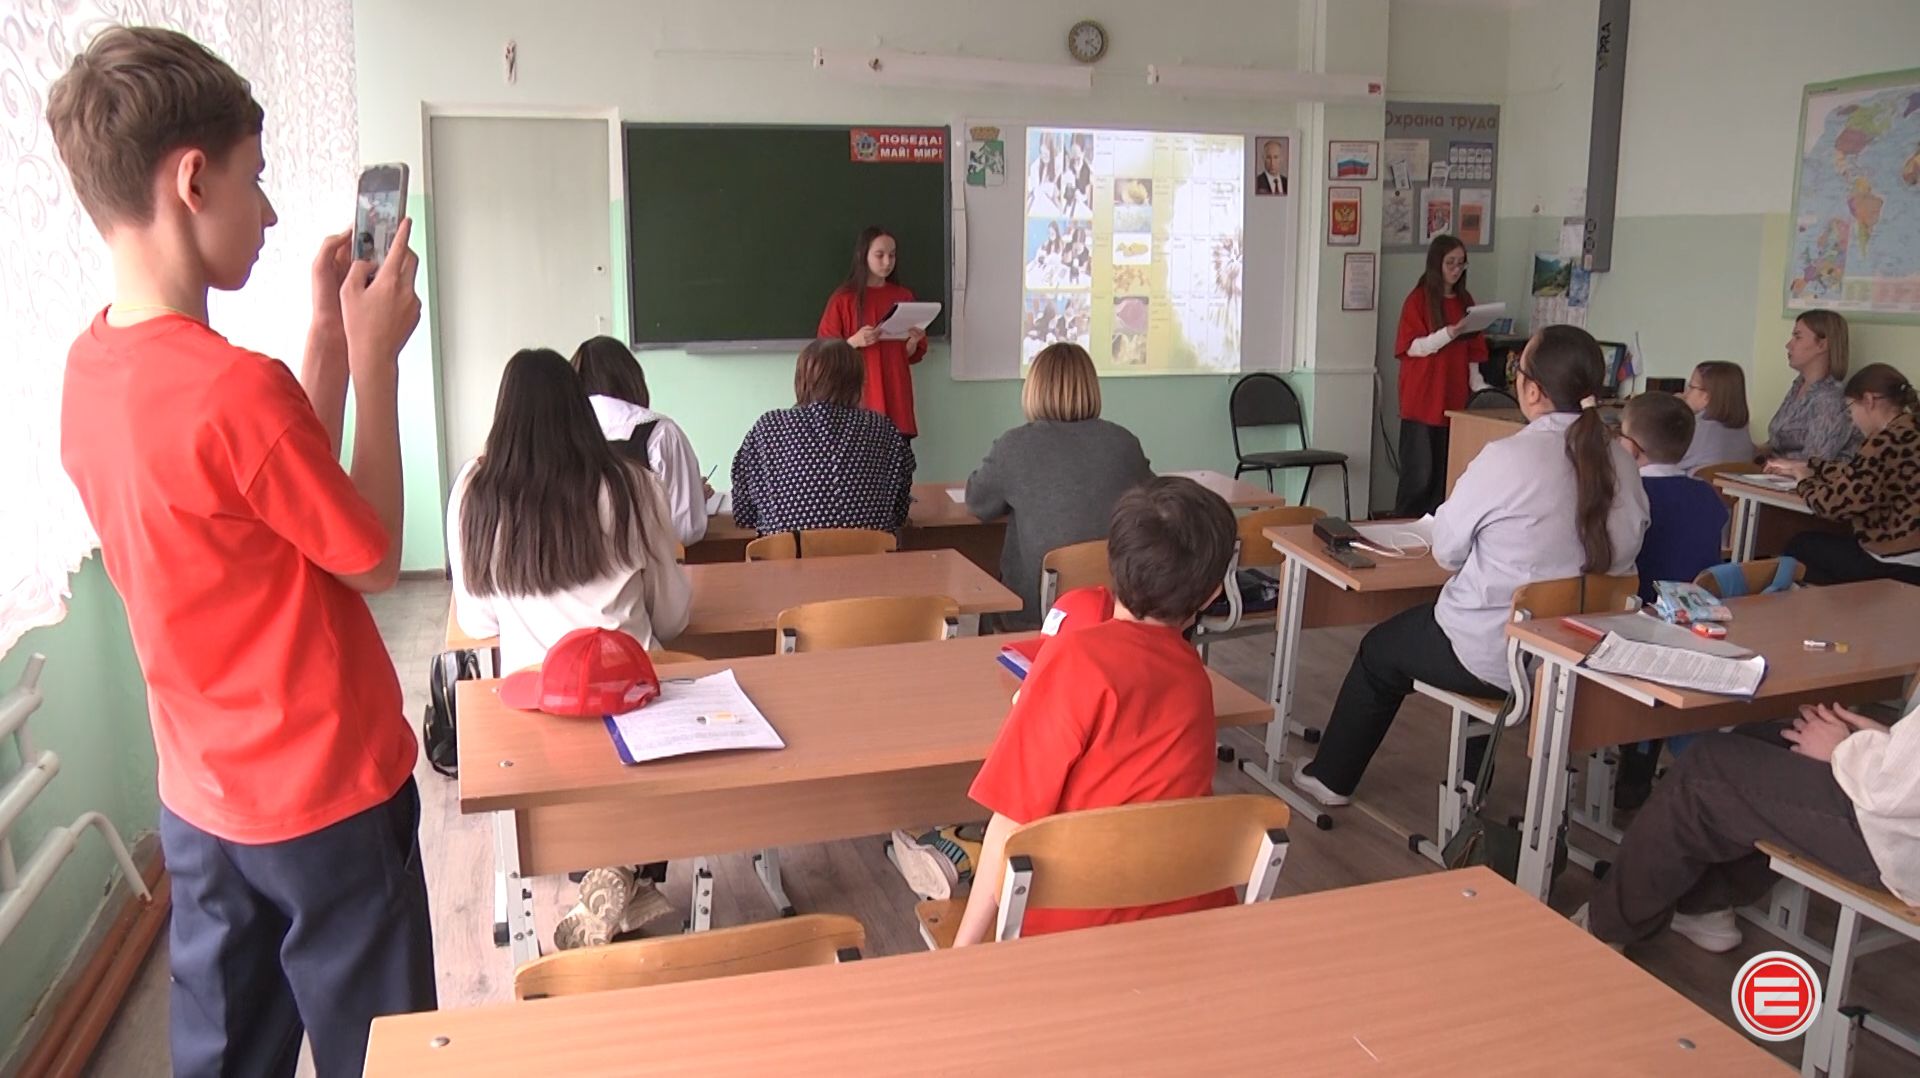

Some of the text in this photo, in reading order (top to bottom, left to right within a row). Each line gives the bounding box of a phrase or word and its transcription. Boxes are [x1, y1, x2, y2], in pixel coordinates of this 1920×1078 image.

[1450, 116, 1496, 131] труда
[879, 134, 942, 146] ПОБЕДА!
[880, 146, 942, 159] МАЙ! МИР!
